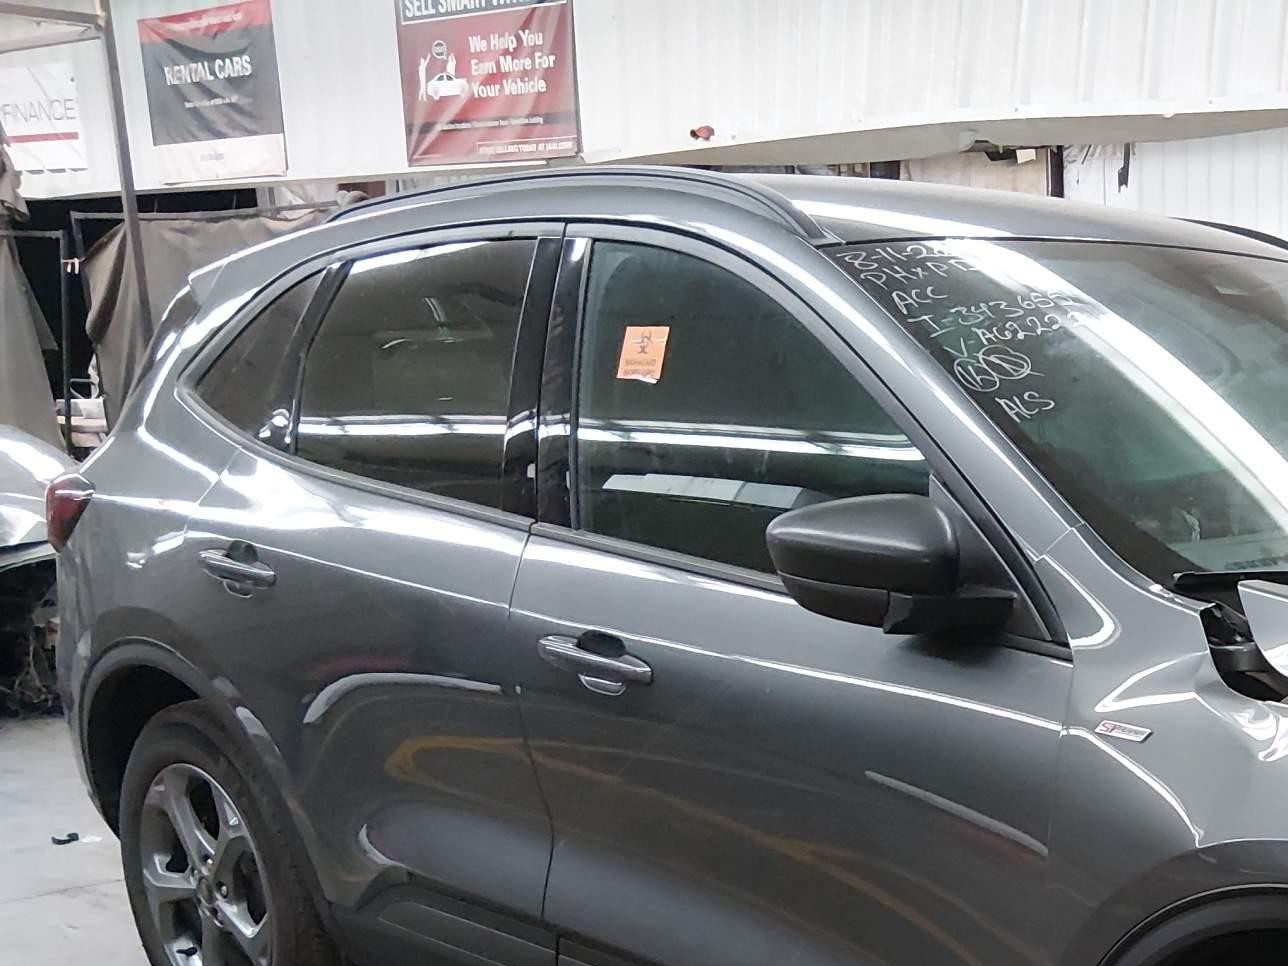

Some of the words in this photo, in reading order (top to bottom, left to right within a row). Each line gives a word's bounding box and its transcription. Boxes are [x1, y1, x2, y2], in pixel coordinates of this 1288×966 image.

[405, 0, 436, 18] SELL
[468, 35, 488, 53] We
[490, 33, 517, 51] Help
[519, 29, 543, 47] You
[164, 61, 214, 86] RENTAL
[214, 55, 252, 79] CARS
[499, 55, 532, 72] More
[534, 52, 556, 69] For
[471, 82, 500, 98] Your
[502, 78, 547, 95] Vehicle
[2, 98, 77, 123] FINANCE
[891, 286, 949, 314] ACC
